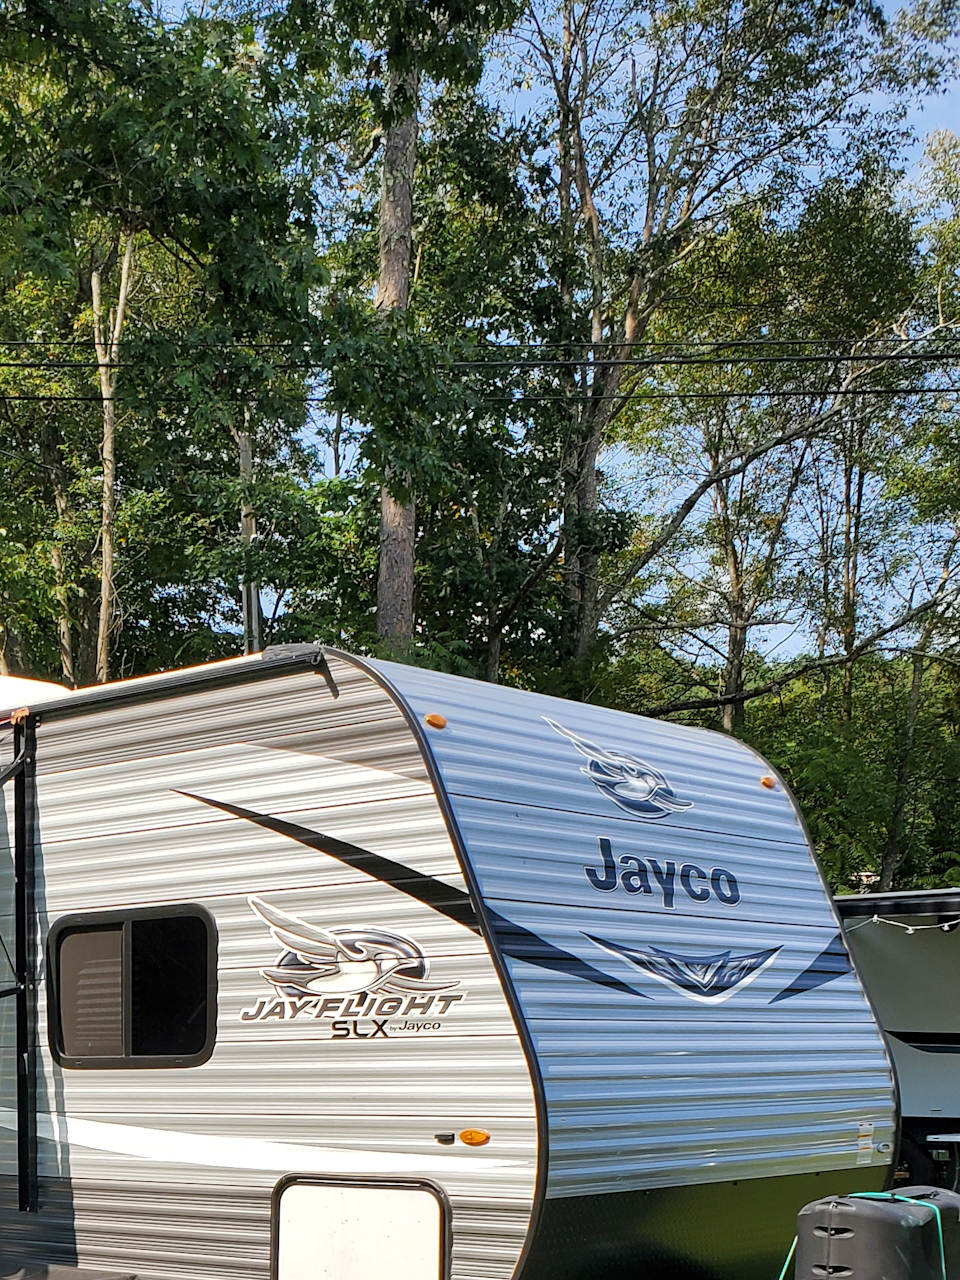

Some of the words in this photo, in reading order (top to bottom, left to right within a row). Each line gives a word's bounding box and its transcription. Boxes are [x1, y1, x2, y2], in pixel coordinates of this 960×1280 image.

[584, 836, 742, 909] Jayco
[241, 1000, 311, 1021] JAY
[315, 994, 464, 1019] FLIGHT
[331, 1019, 389, 1039] SLX
[398, 1020, 441, 1033] Jayco
